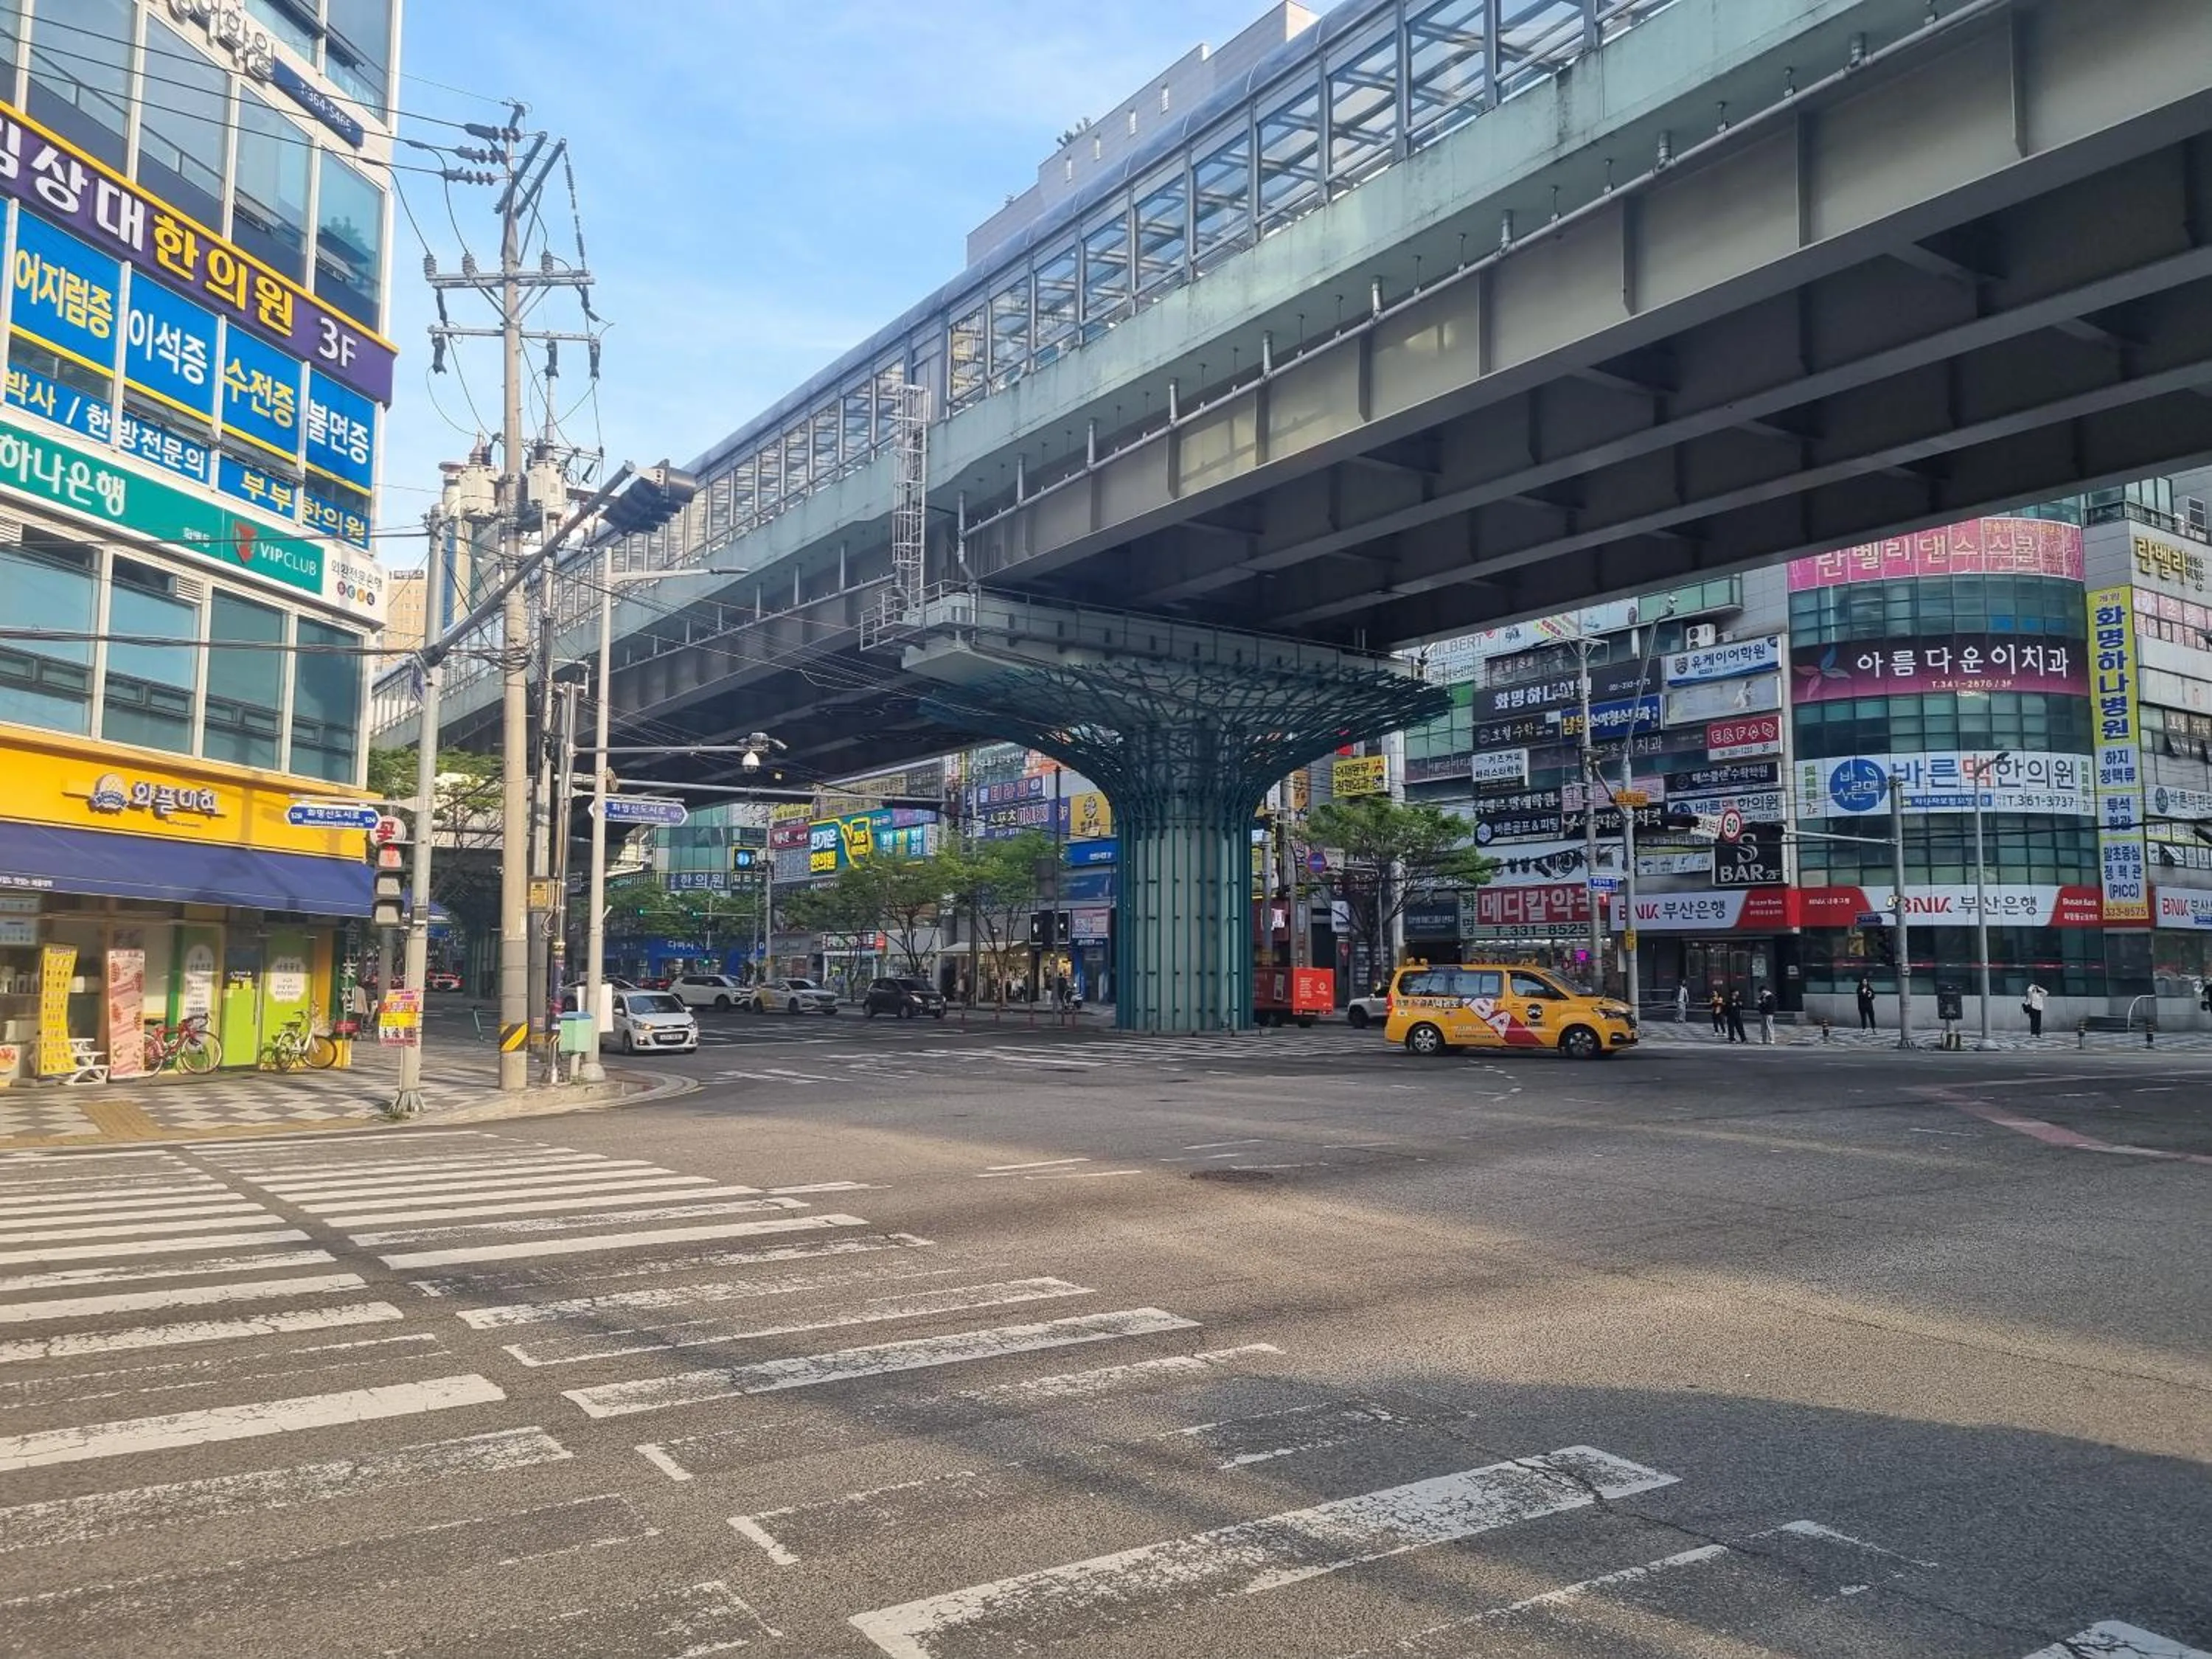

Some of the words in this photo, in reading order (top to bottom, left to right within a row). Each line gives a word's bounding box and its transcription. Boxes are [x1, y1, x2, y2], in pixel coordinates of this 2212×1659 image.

[15, 248, 114, 339] 어지럼증
[128, 309, 207, 386] 이석증
[223, 358, 296, 429] 수전증
[307, 398, 369, 465] 불면증
[319, 317, 358, 367] 3F
[4, 370, 56, 417] 박사
[86, 402, 206, 479] 한방전문의
[0, 433, 126, 517] 하나은행
[2135, 535, 2186, 585] 란벨리
[1856, 643, 2070, 679] 아름다운이치과
[2095, 605, 2129, 741] 화명하나병원
[2105, 749, 2129, 765] 하지
[307, 808, 361, 819] 화명신도시로
[679, 874, 726, 888] 한의원
[1719, 864, 1764, 883] BAR
[2109, 883, 2140, 899] (PICC)
[1663, 899, 1726, 920] 부산은행
[1958, 895, 2038, 917] 부산은행
